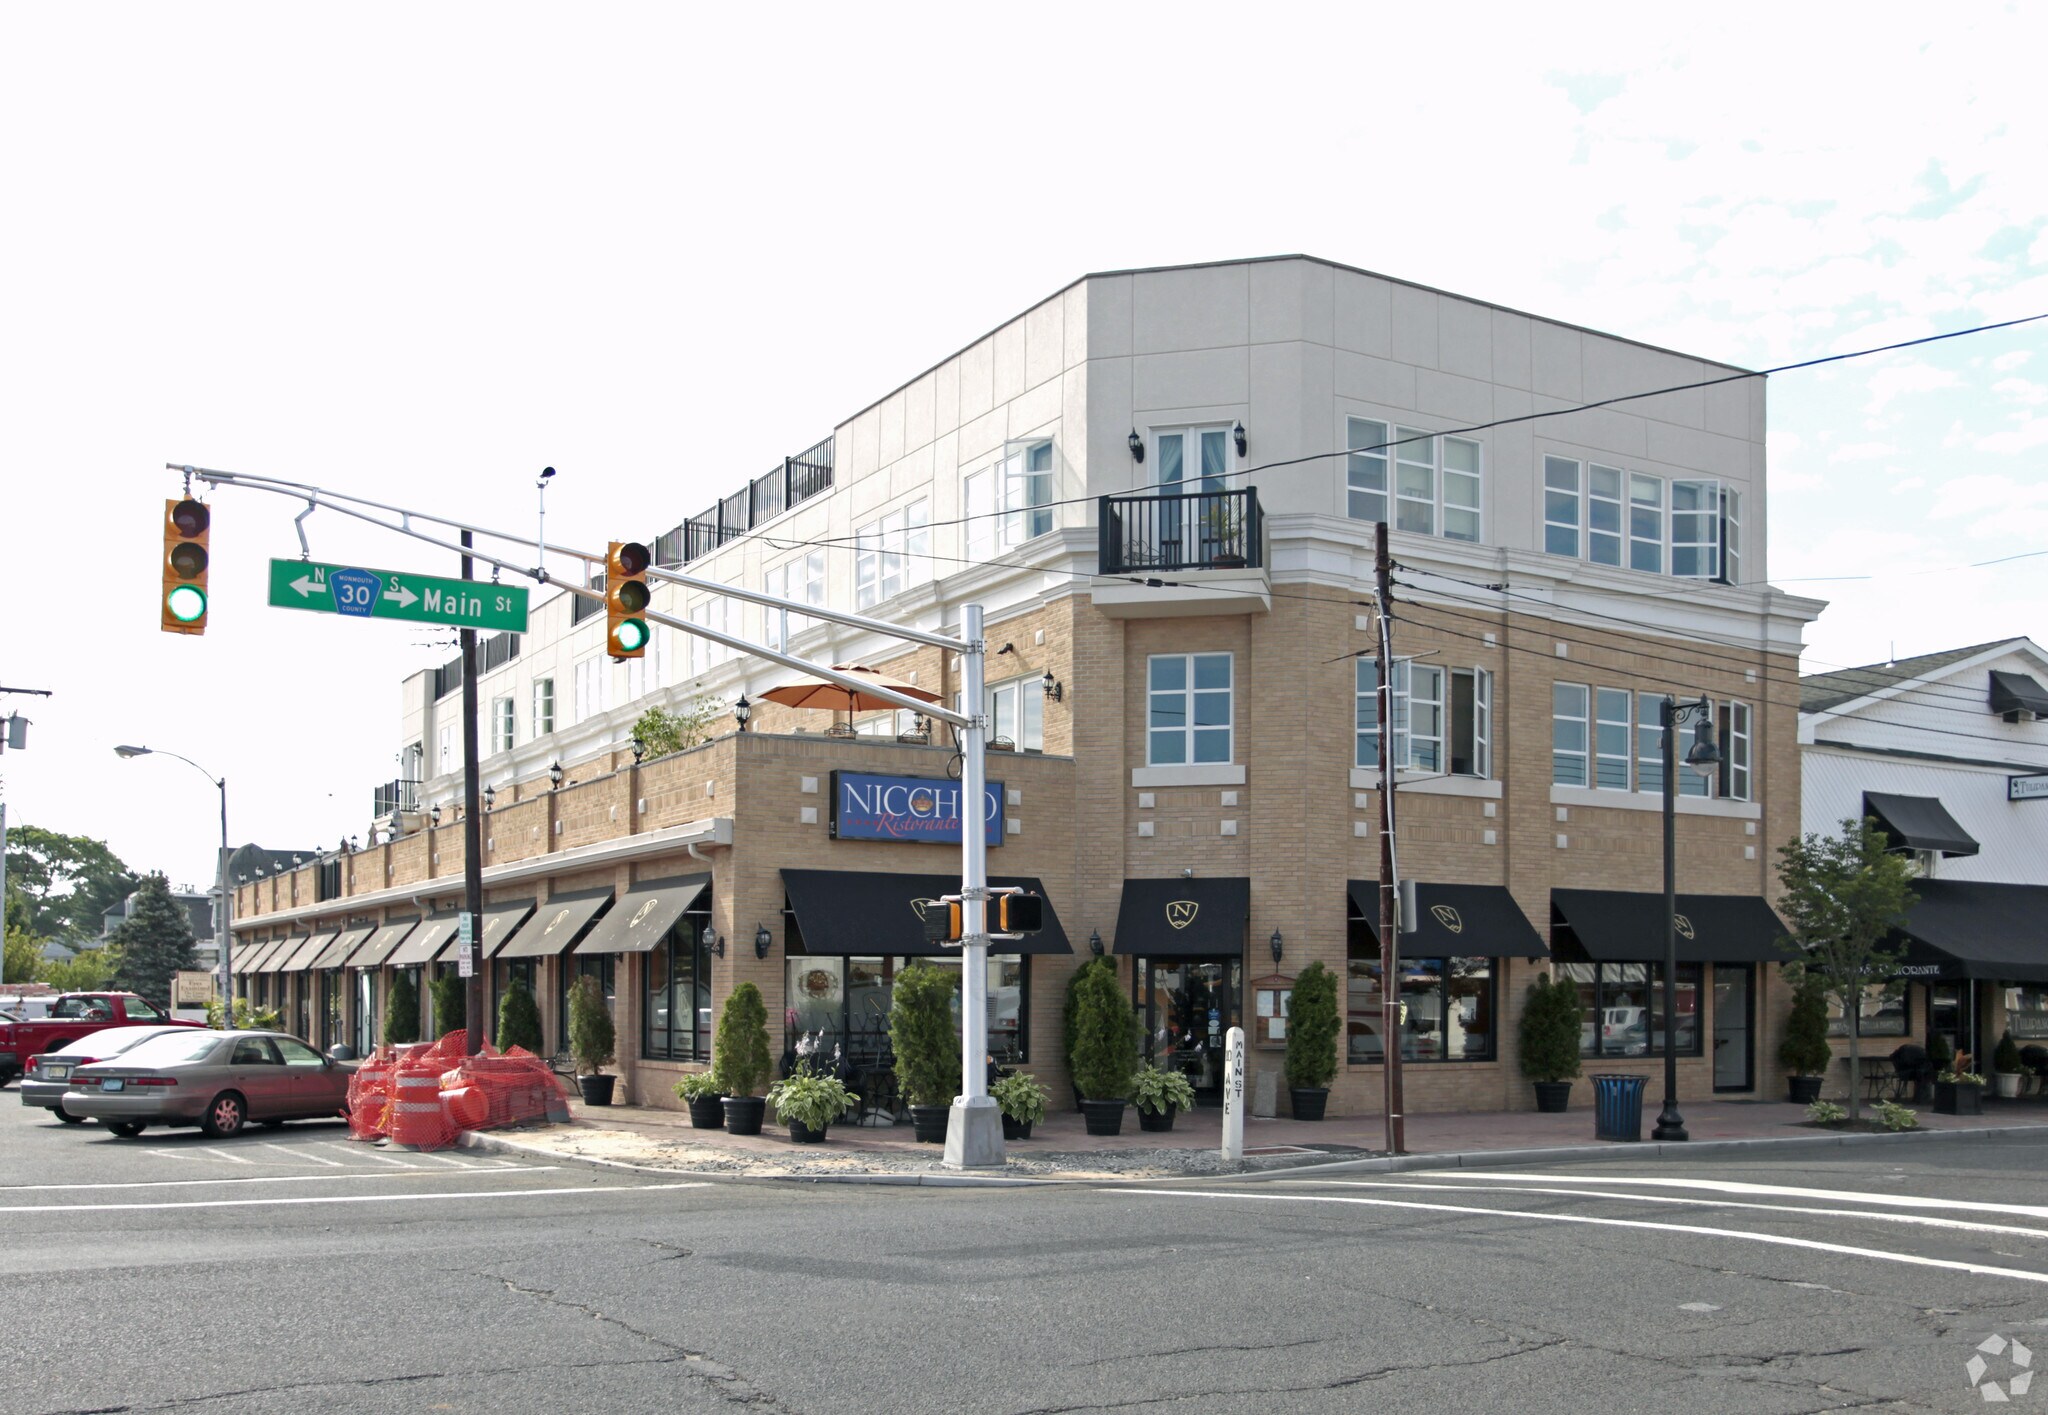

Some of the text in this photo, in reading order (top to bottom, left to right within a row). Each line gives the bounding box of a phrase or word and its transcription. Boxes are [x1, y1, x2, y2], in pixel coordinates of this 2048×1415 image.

[314, 567, 325, 583] N
[338, 575, 374, 585] MONMOUTH
[389, 576, 399, 592] S
[340, 584, 370, 605] 30
[423, 588, 512, 617] Main St
[342, 605, 367, 613] COUNTY
[844, 782, 998, 821] NICCH
[876, 812, 959, 838] Ristorante
[1234, 1040, 1243, 1098] MAIN ST
